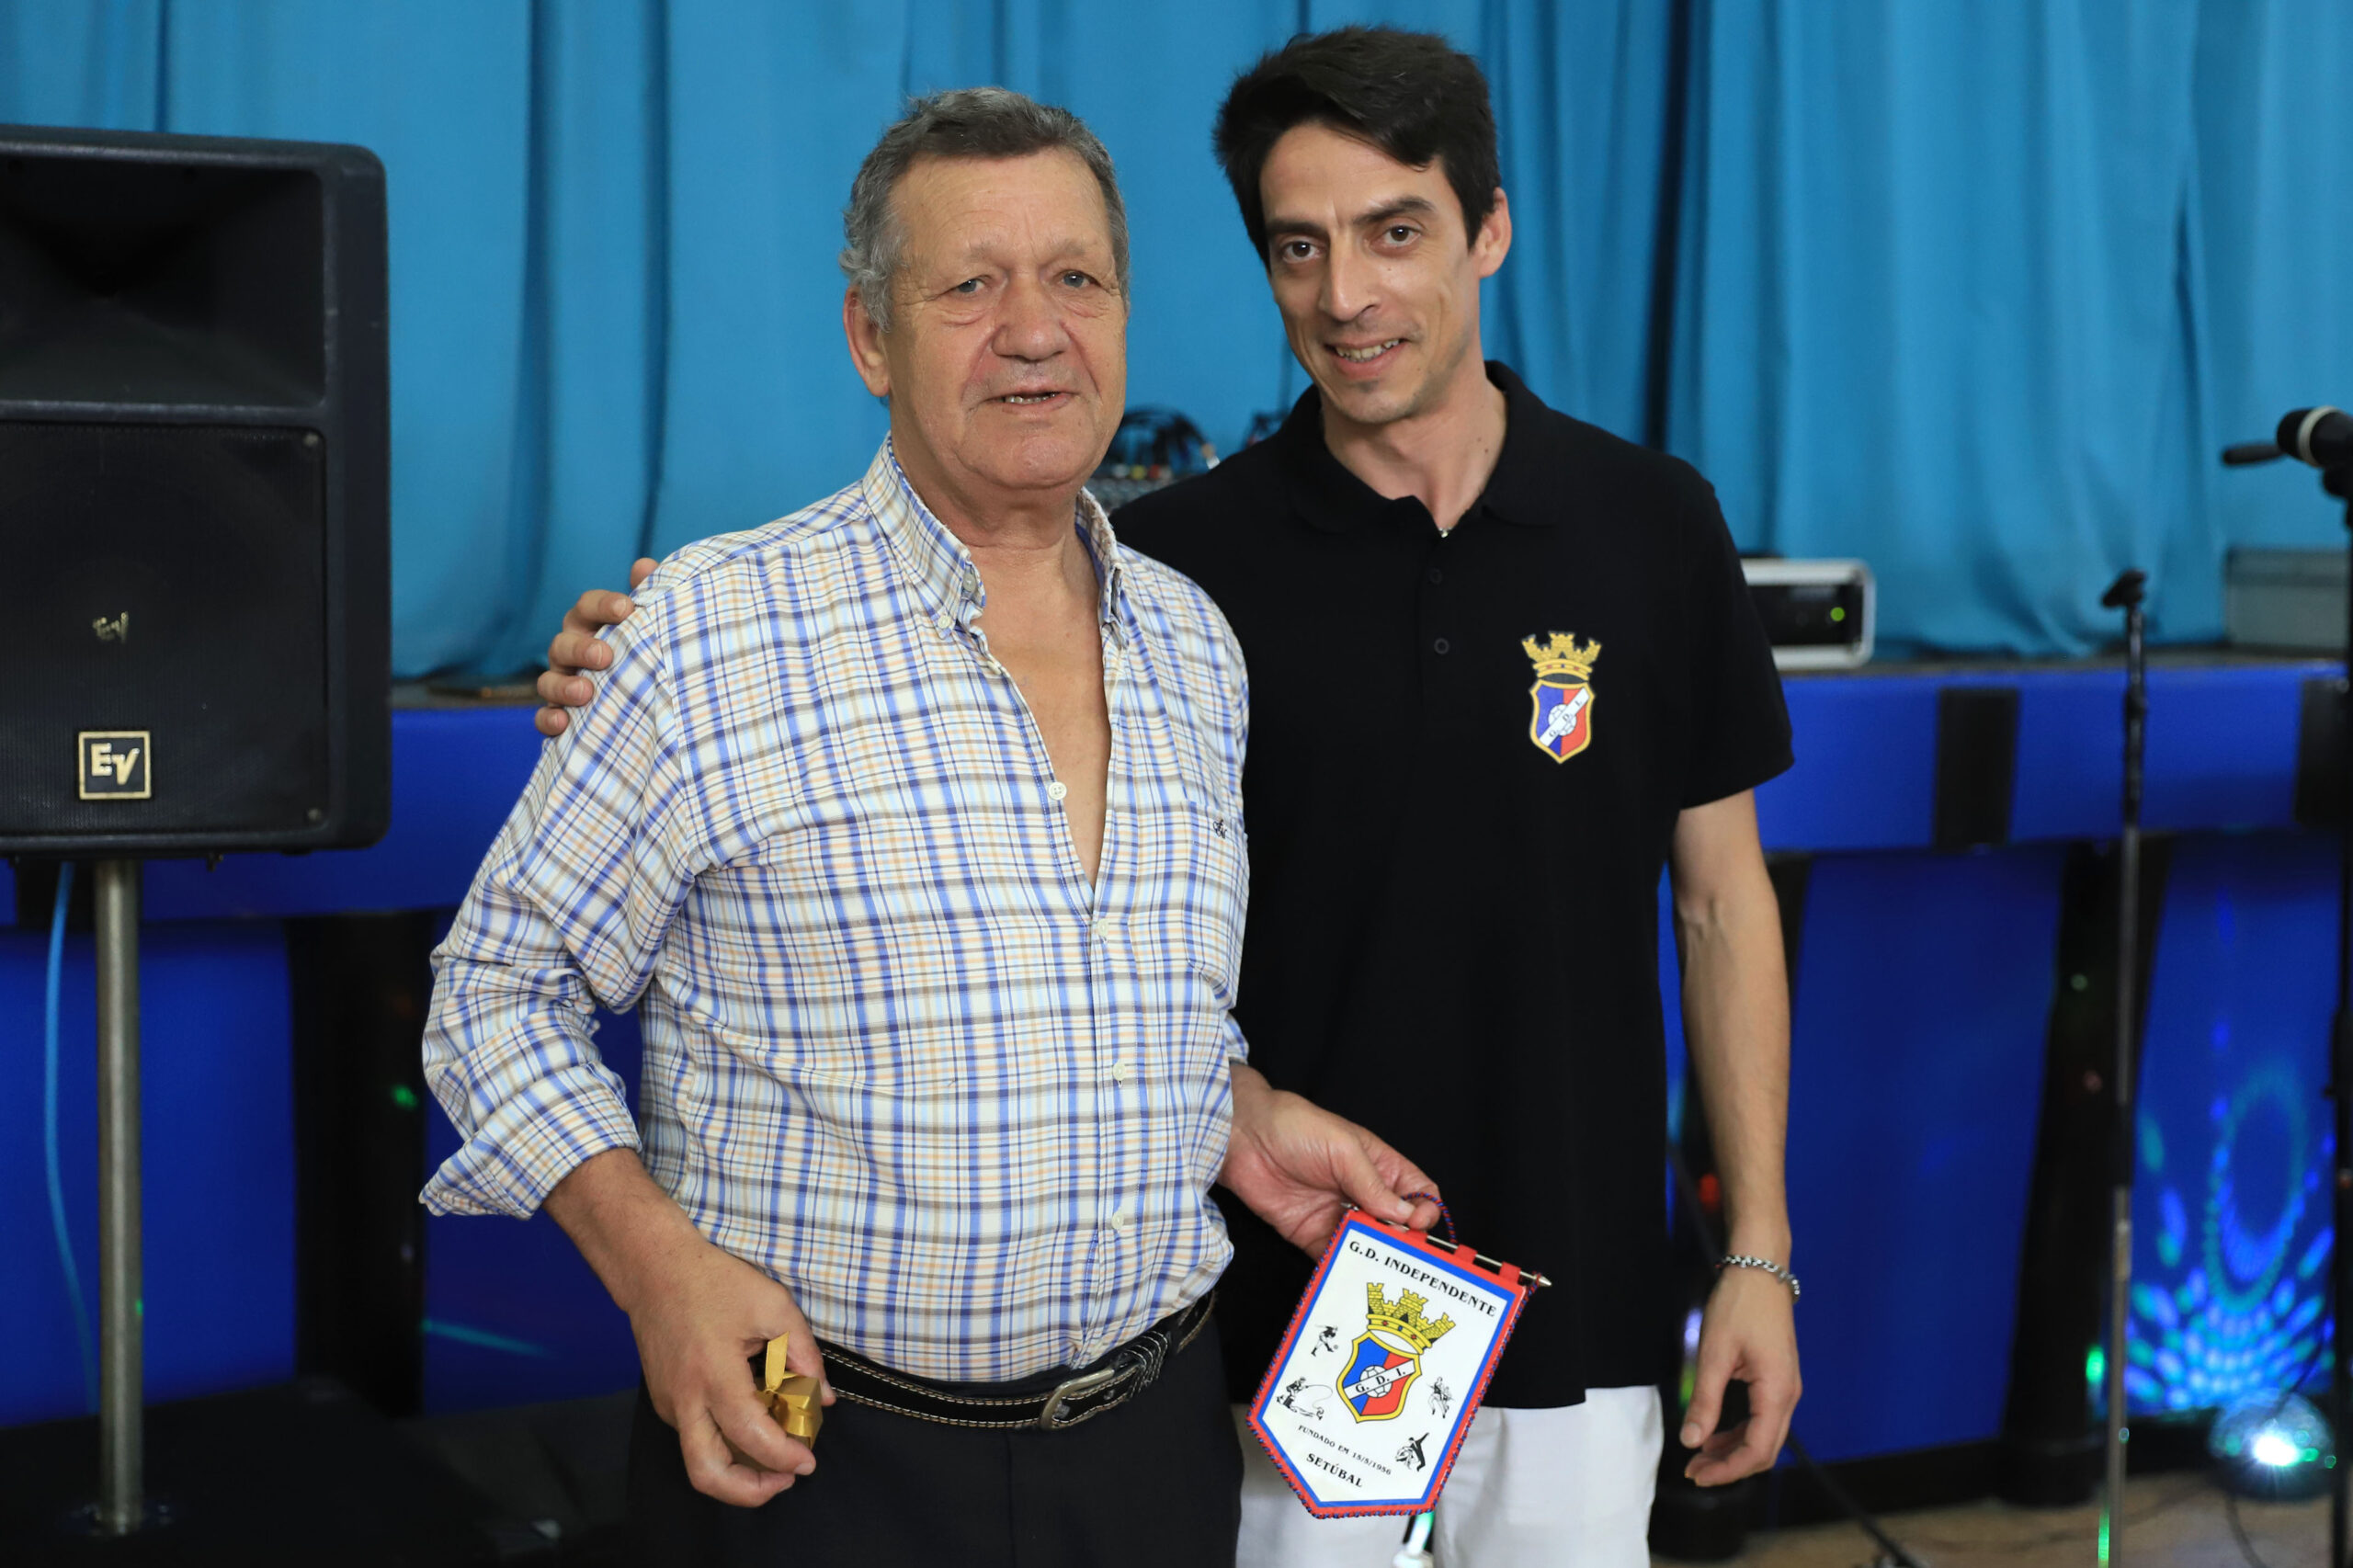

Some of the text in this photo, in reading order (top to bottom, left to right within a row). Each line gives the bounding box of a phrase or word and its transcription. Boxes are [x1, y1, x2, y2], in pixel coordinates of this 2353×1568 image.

[1384, 1256, 1497, 1317] INDEPENDENTE
[1298, 1424, 1336, 1448] FUNDADO
[1337, 1444, 1350, 1455] EM
[1306, 1452, 1362, 1488] SETÚBAL
